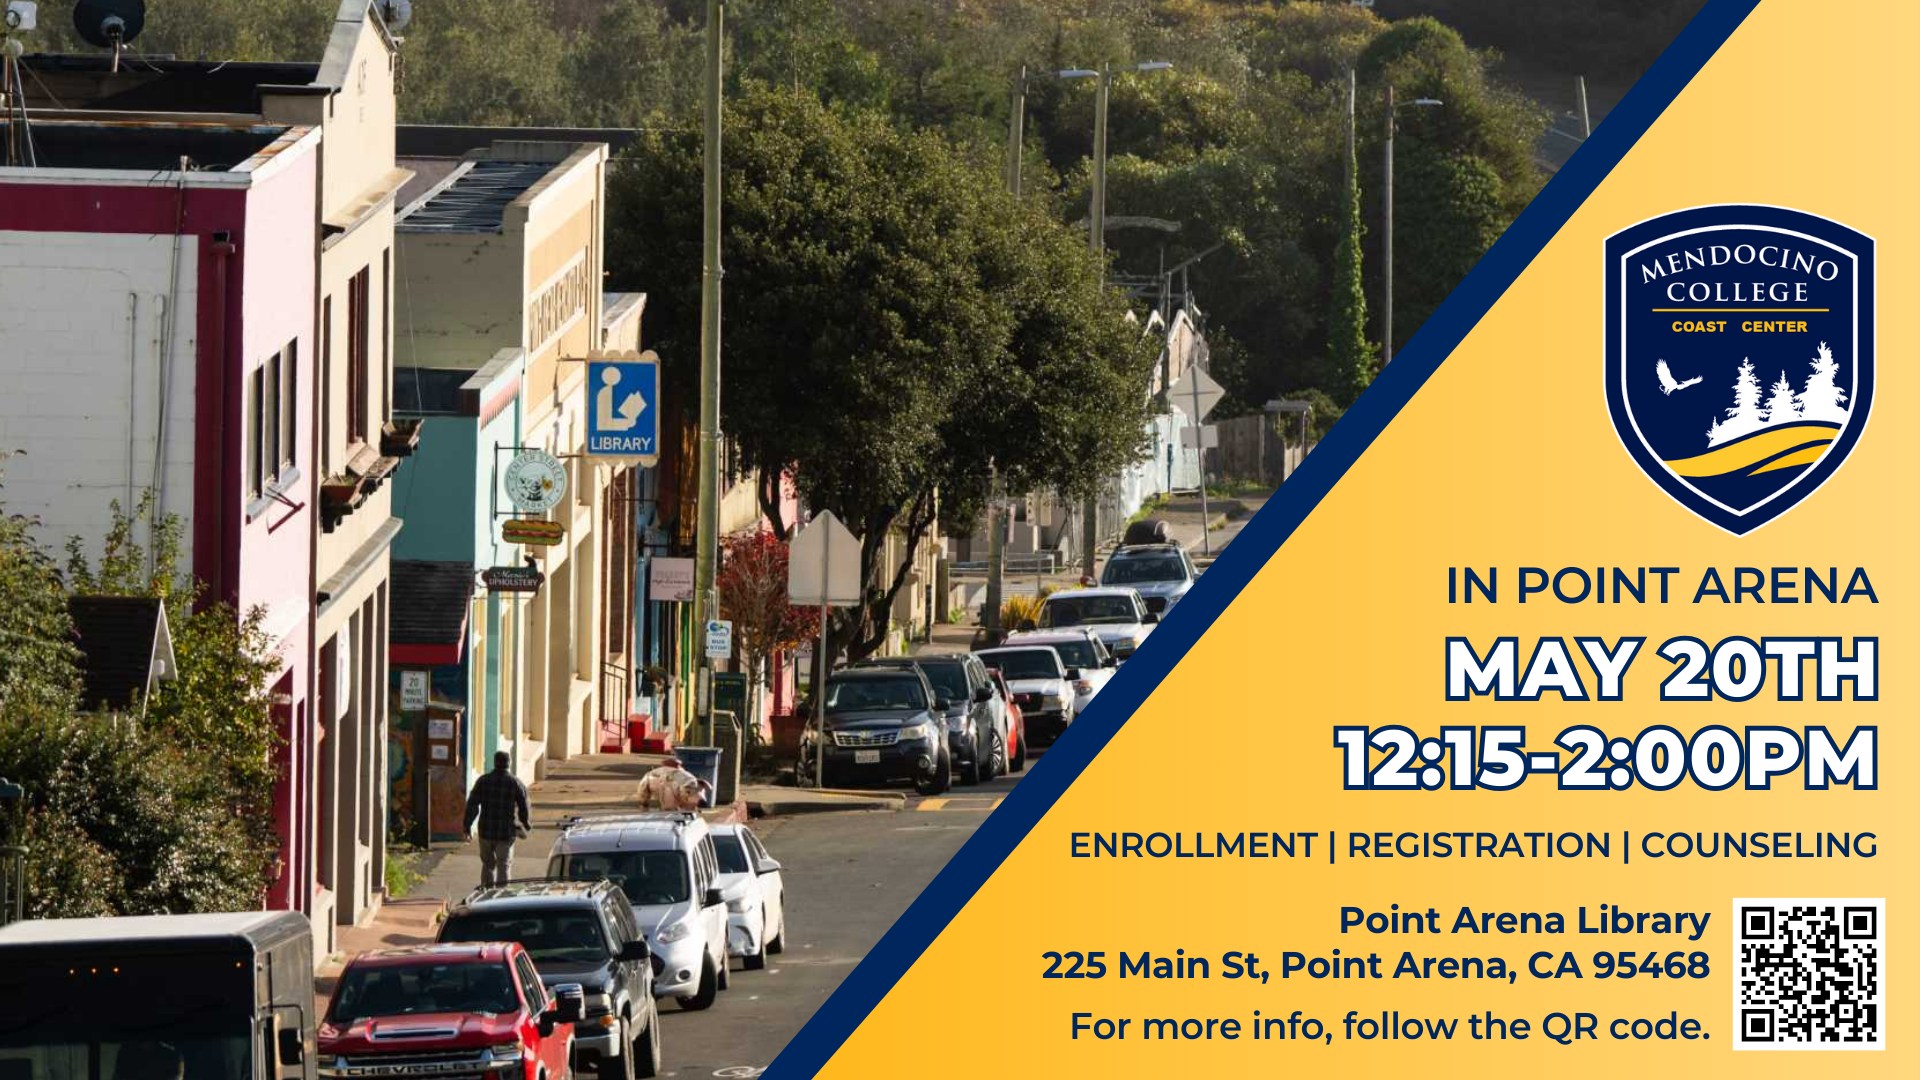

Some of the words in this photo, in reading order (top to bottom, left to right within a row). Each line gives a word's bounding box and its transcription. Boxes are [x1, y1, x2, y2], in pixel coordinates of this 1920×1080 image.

[591, 436, 652, 451] LIBRARY
[489, 577, 540, 587] UPHOLSTERY
[347, 1062, 482, 1076] CHEVROLET
